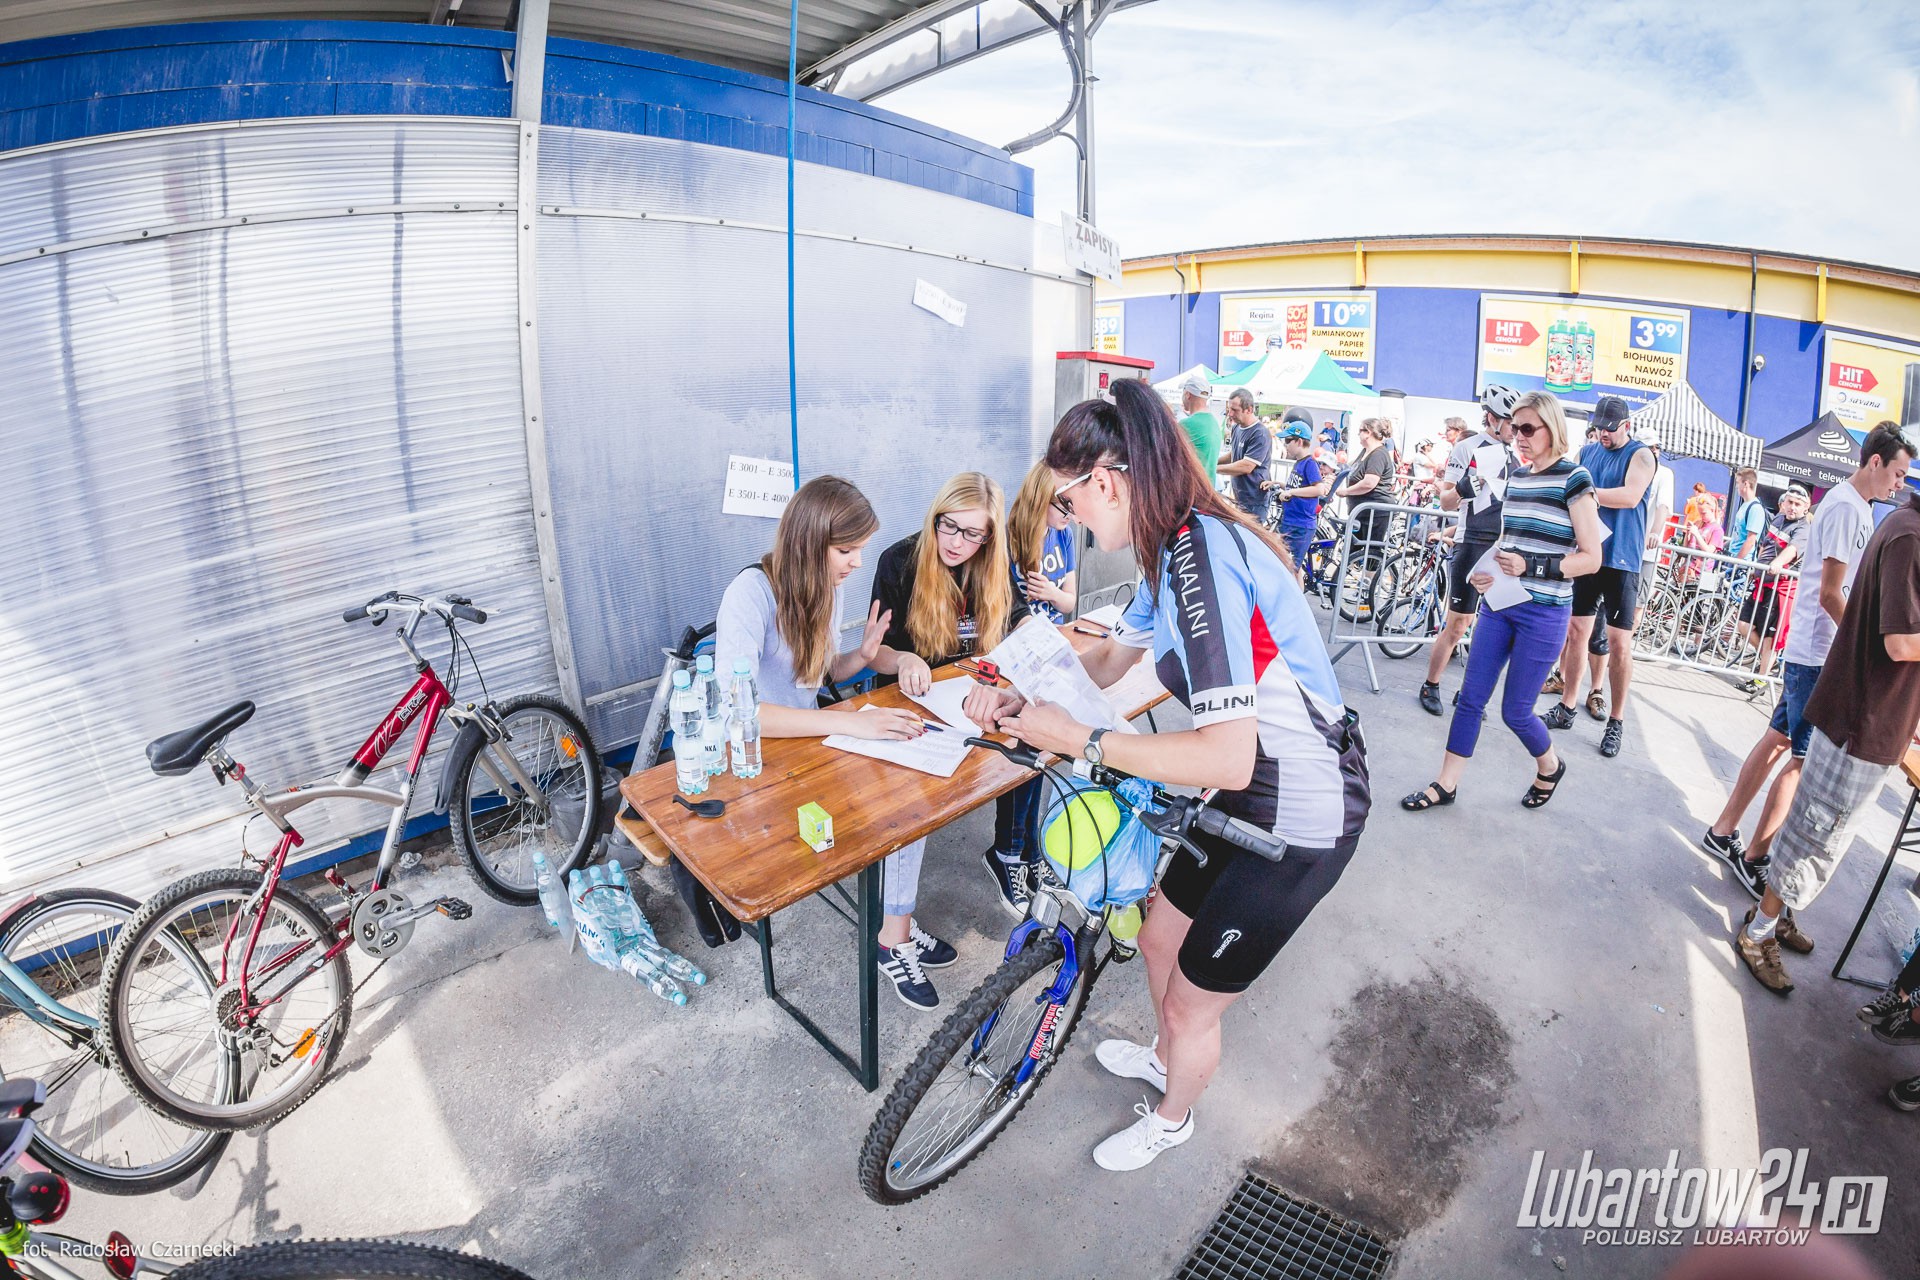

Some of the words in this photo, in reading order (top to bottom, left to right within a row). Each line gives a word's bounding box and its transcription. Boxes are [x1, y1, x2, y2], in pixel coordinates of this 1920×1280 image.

[1075, 222, 1113, 257] ZAPISY
[1249, 311, 1274, 319] Regina
[1312, 330, 1365, 338] RUMIANKOWY
[1496, 321, 1523, 337] HIT
[1229, 332, 1245, 342] HIT
[1495, 336, 1523, 344] CENOWY
[1323, 349, 1364, 358] OALETOWY
[1623, 351, 1674, 365] BIOHUMUS
[1635, 365, 1673, 377] NAWÓZ
[1839, 366, 1864, 383] HIT
[1615, 374, 1672, 389] NATURALNY
[1838, 380, 1863, 389] CENOWY
[730, 461, 736, 471] E
[739, 463, 758, 474] 3001
[768, 466, 775, 476] E
[1776, 461, 1812, 477] internet
[1818, 471, 1848, 485] telewi
[728, 488, 735, 497] E
[763, 492, 769, 502] E
[771, 493, 790, 504] 4000
[1175, 551, 1209, 639] NALINI
